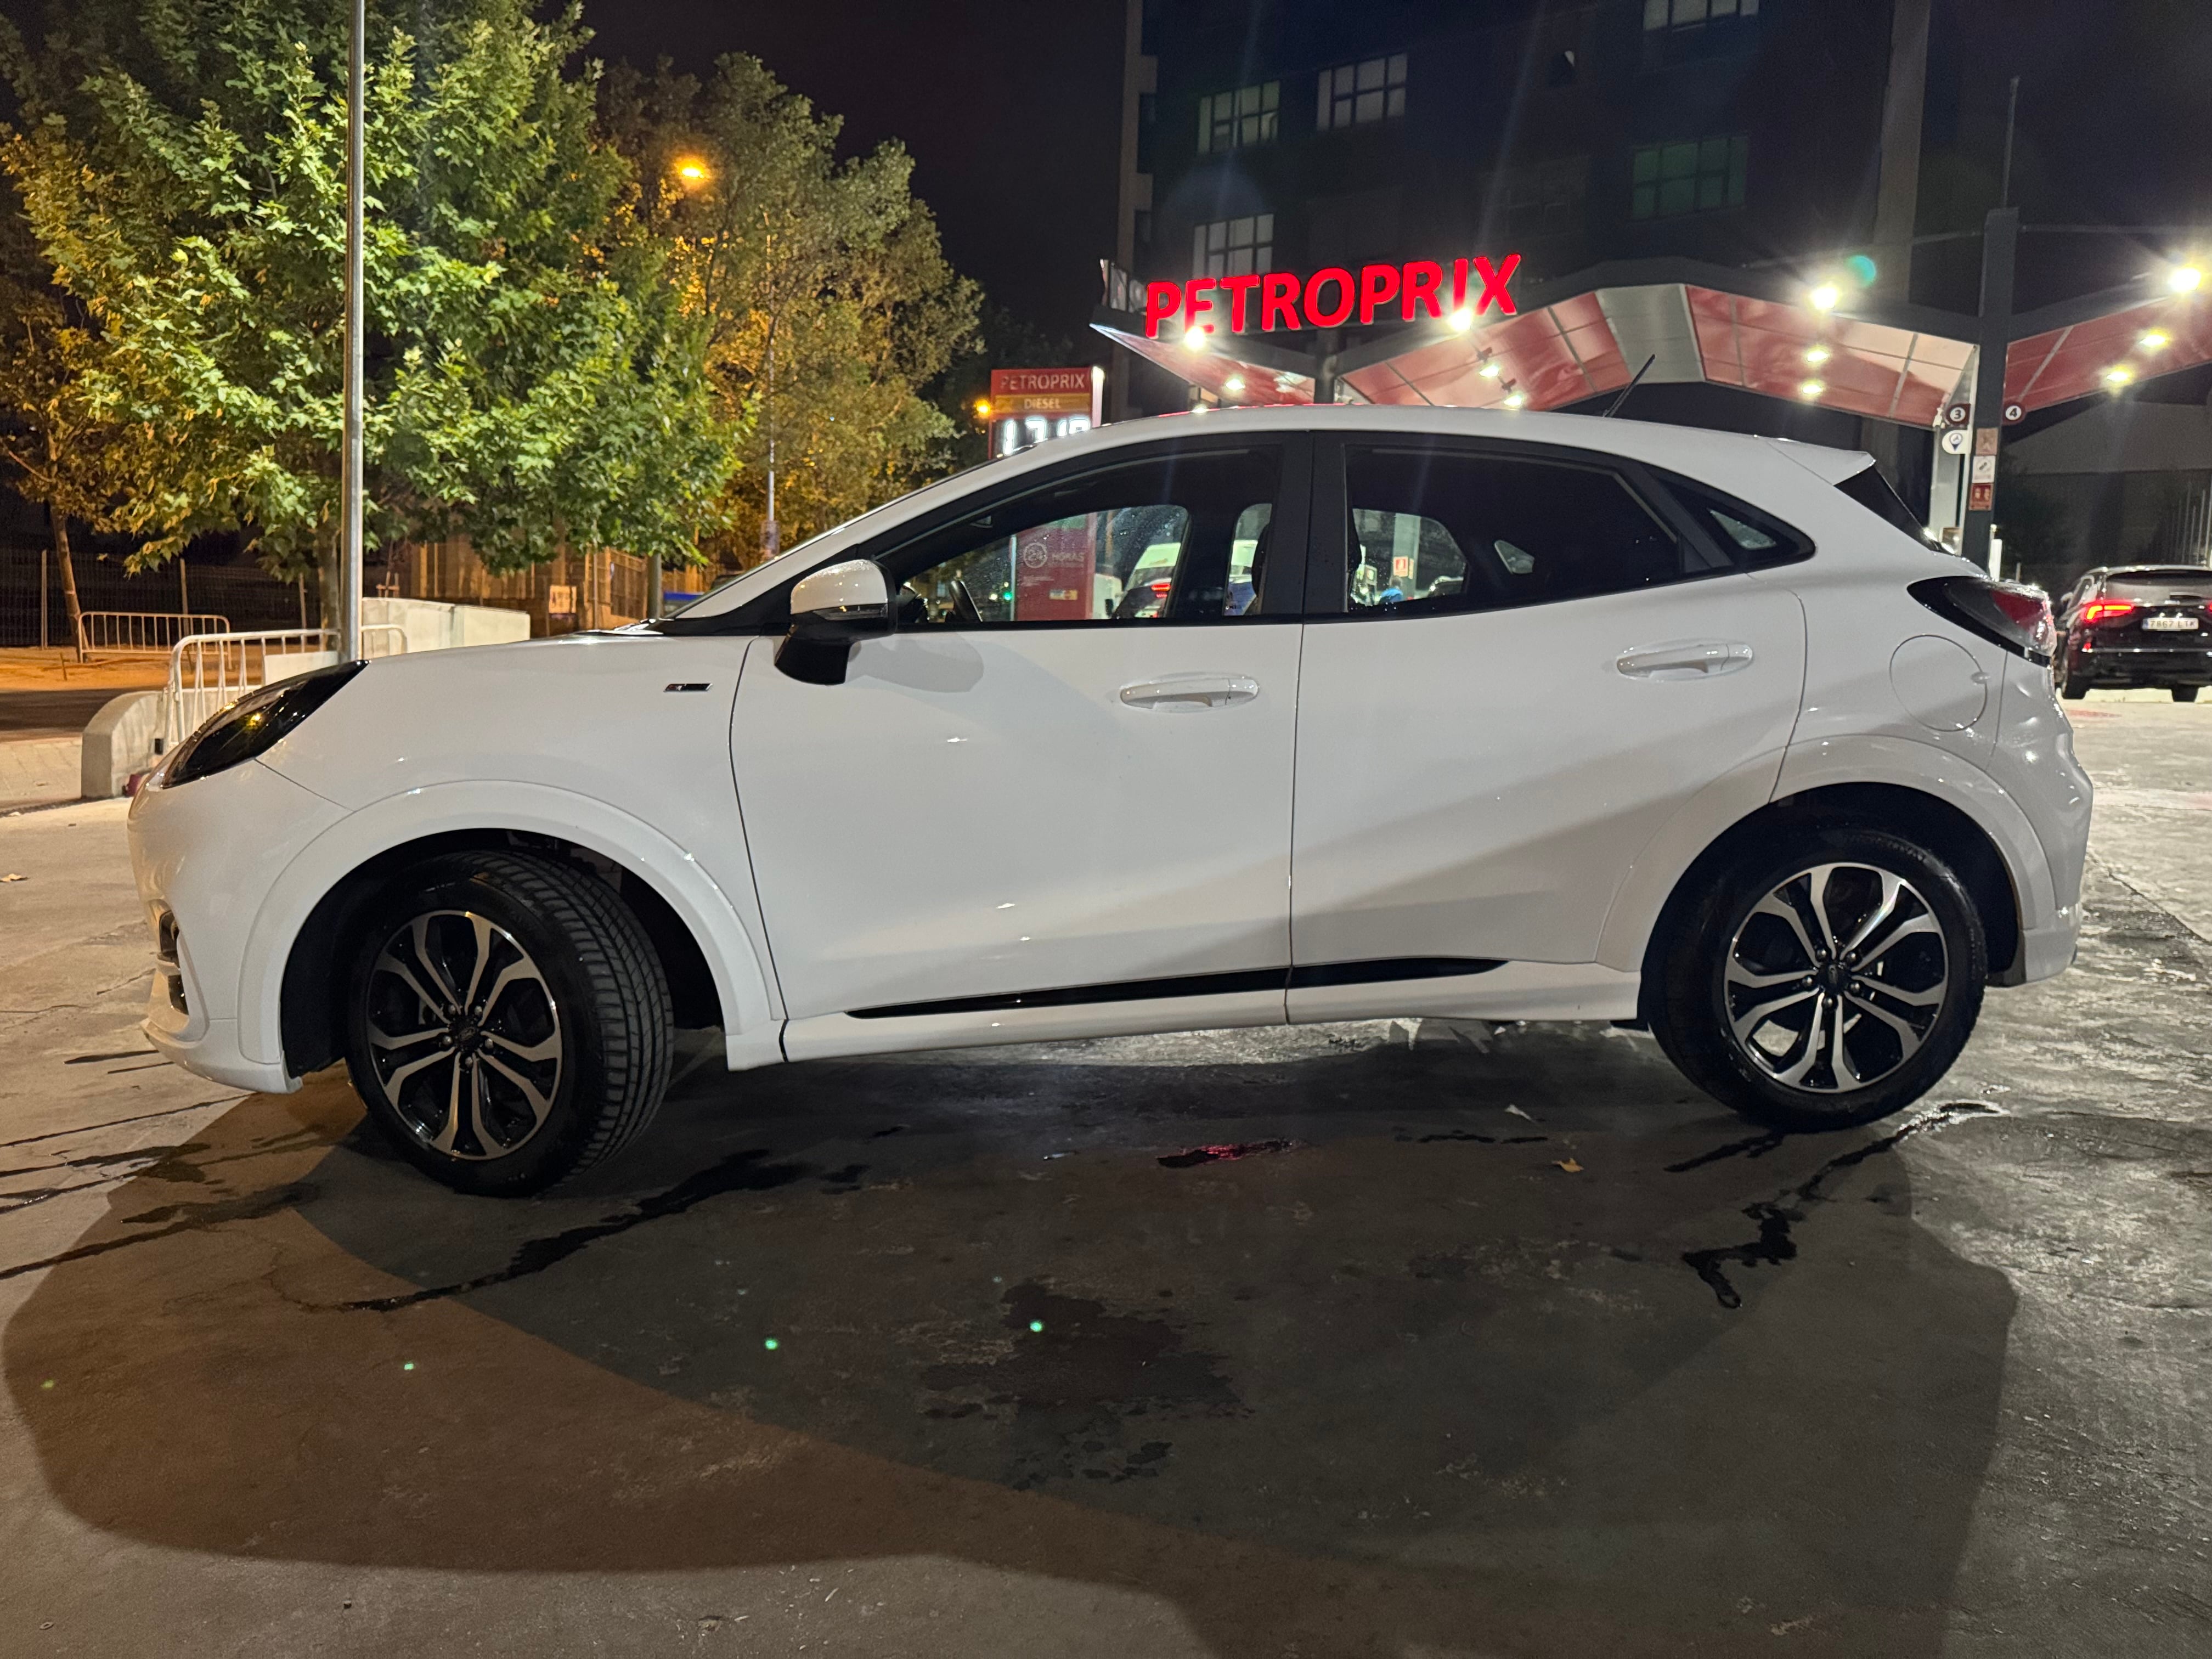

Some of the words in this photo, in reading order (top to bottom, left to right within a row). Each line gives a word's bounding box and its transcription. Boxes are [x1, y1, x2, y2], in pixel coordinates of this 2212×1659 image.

[1146, 254, 1521, 338] PETROPRIX
[1001, 373, 1085, 390] PETROPRIX
[1024, 398, 1062, 409] DIESEL
[1954, 409, 1962, 420] 3
[2009, 408, 2018, 417] 4
[1052, 552, 1085, 562] HORAS
